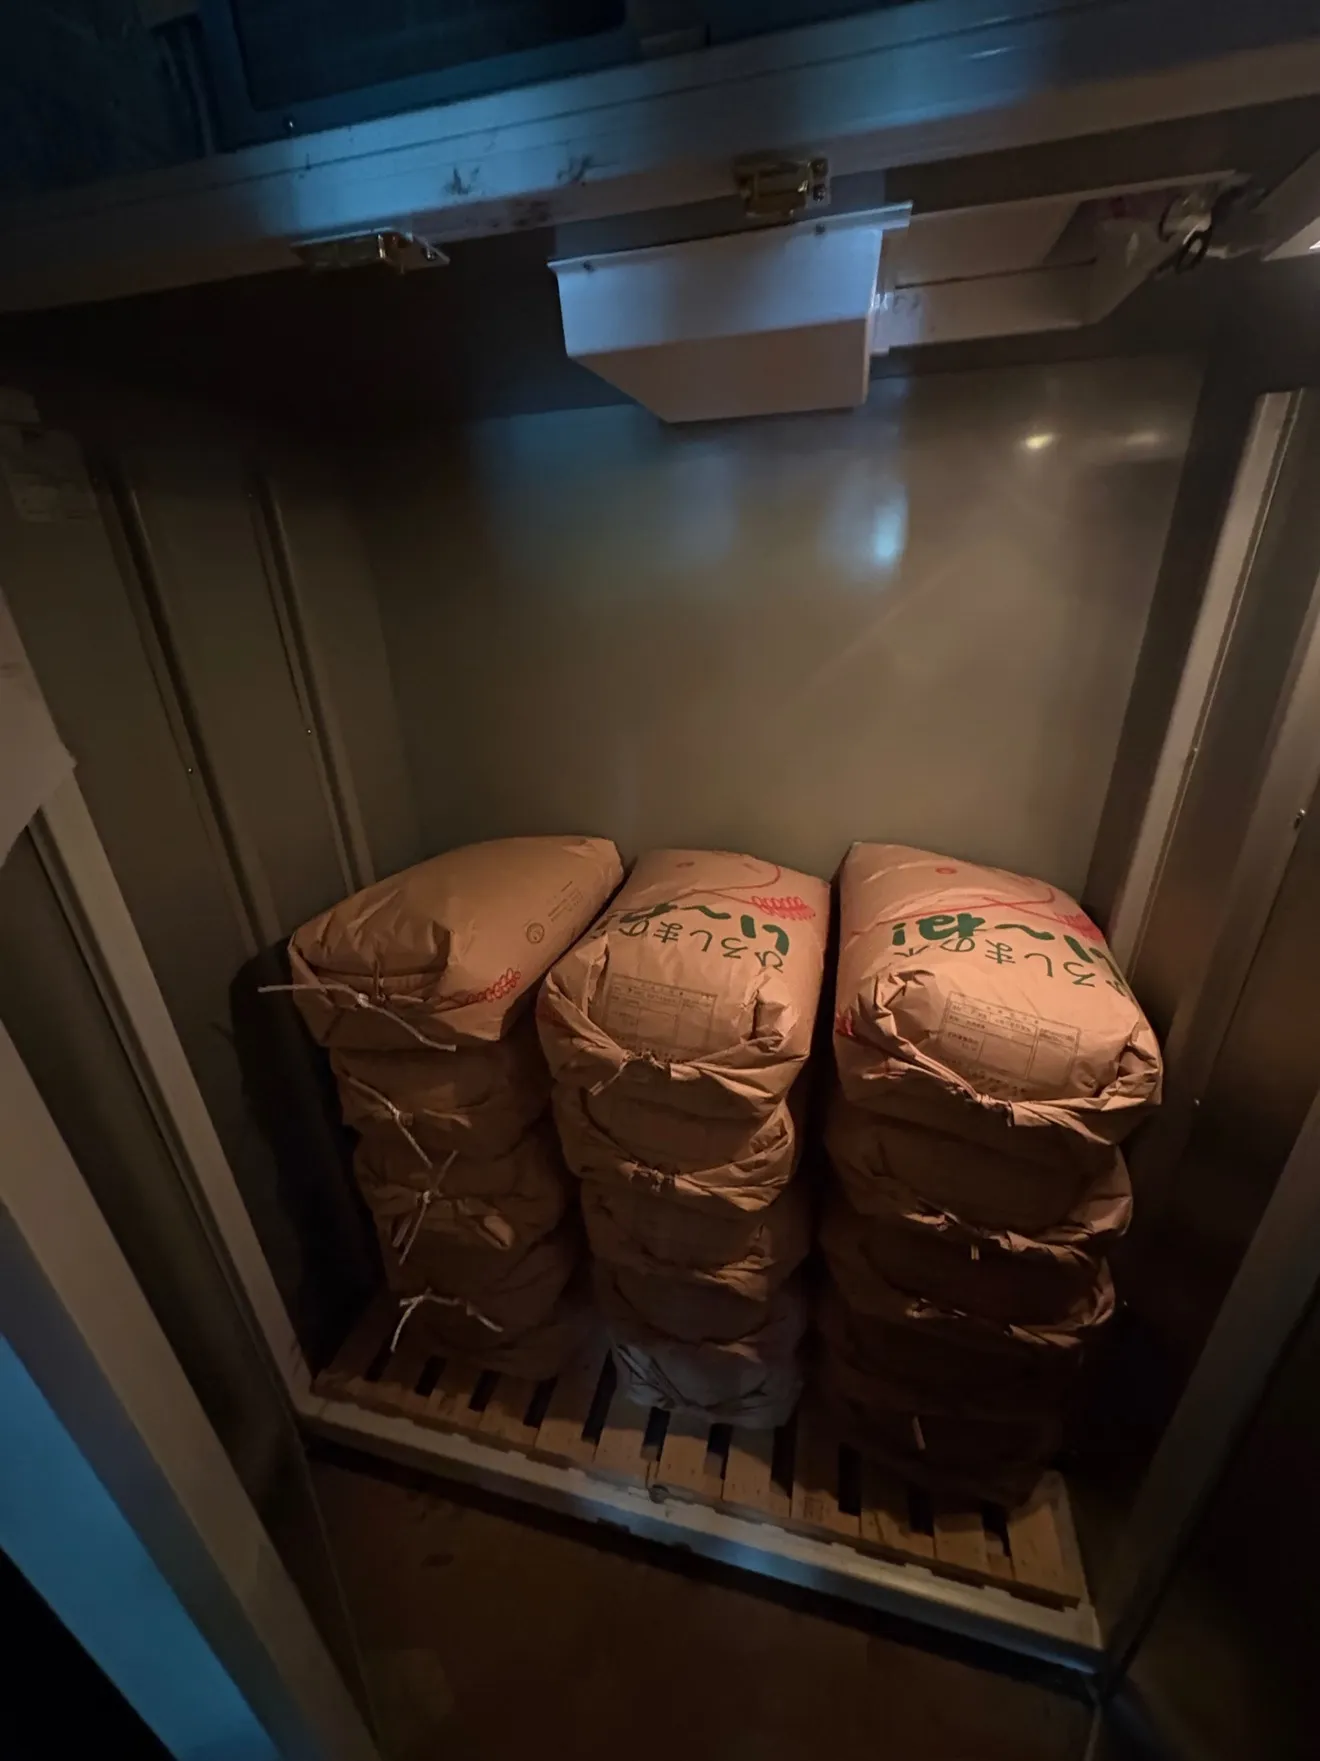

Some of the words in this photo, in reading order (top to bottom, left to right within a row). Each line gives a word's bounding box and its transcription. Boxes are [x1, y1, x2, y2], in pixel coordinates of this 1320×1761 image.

[592, 918, 784, 974] ひろしまの
